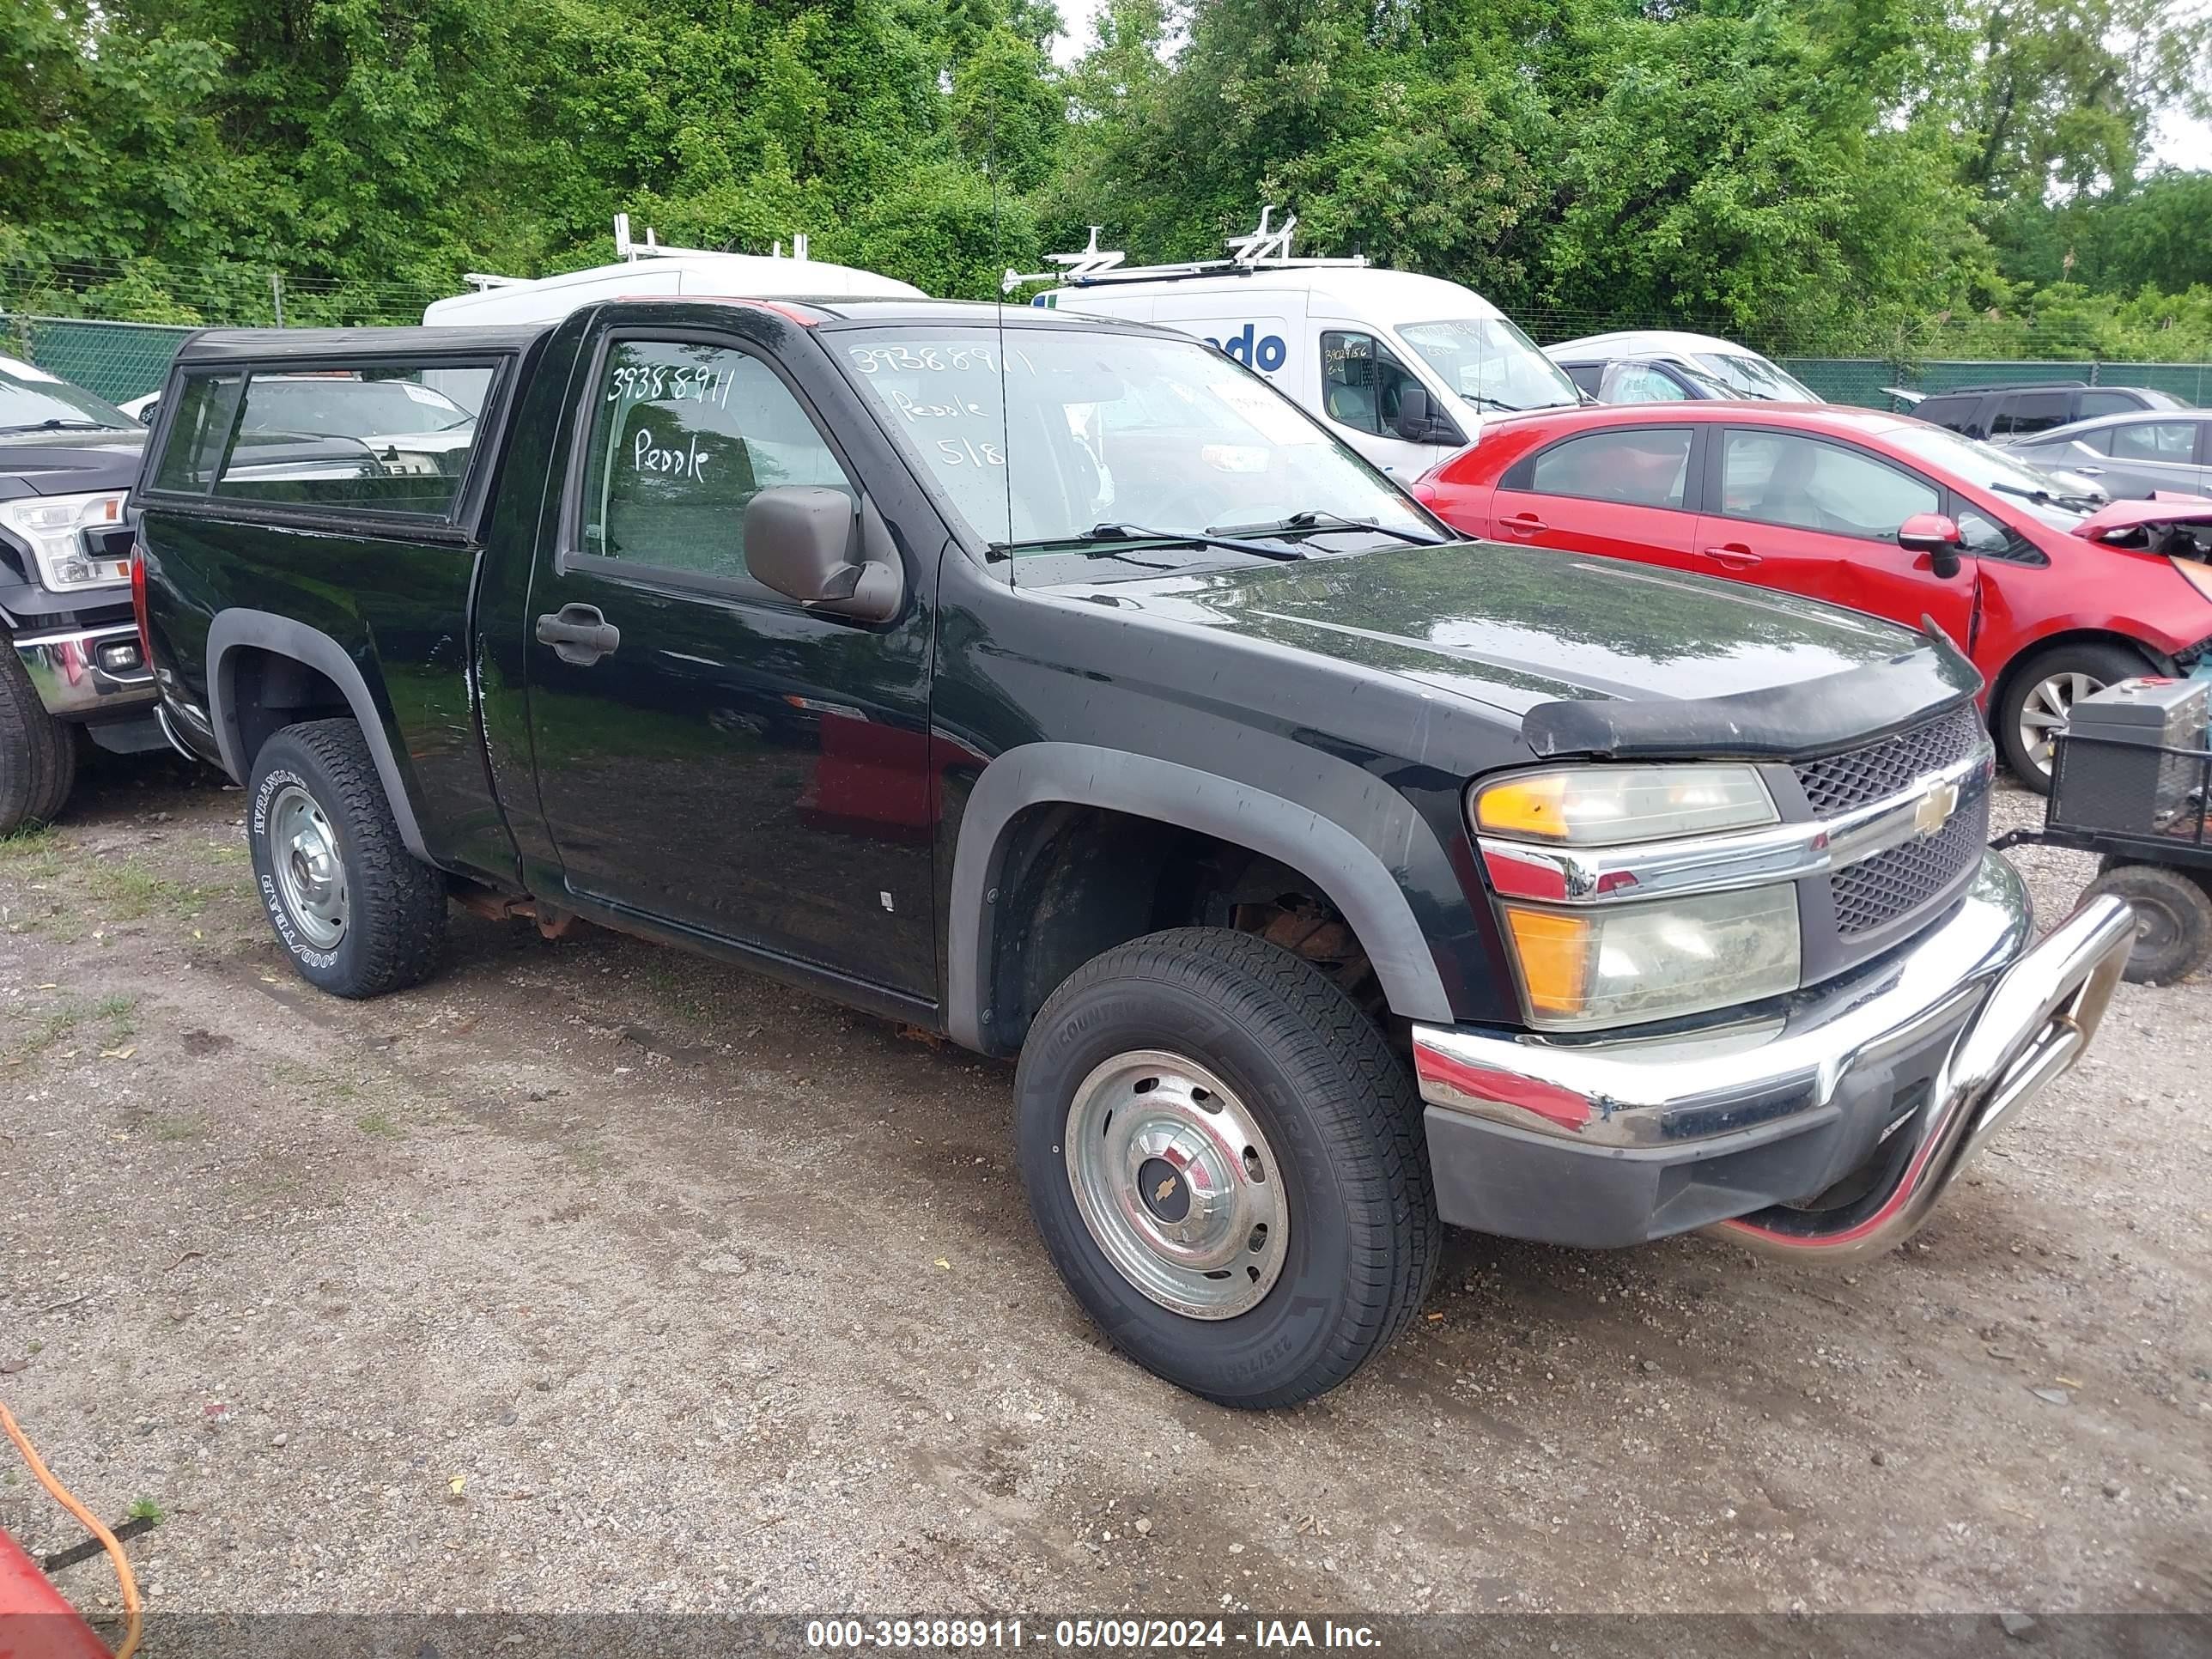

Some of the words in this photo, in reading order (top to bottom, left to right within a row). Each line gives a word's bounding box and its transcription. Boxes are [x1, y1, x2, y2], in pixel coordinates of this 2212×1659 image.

[848, 345, 1038, 378] 39388911
[607, 365, 736, 410] 39388911
[261, 874, 337, 969] GOODYEAR
